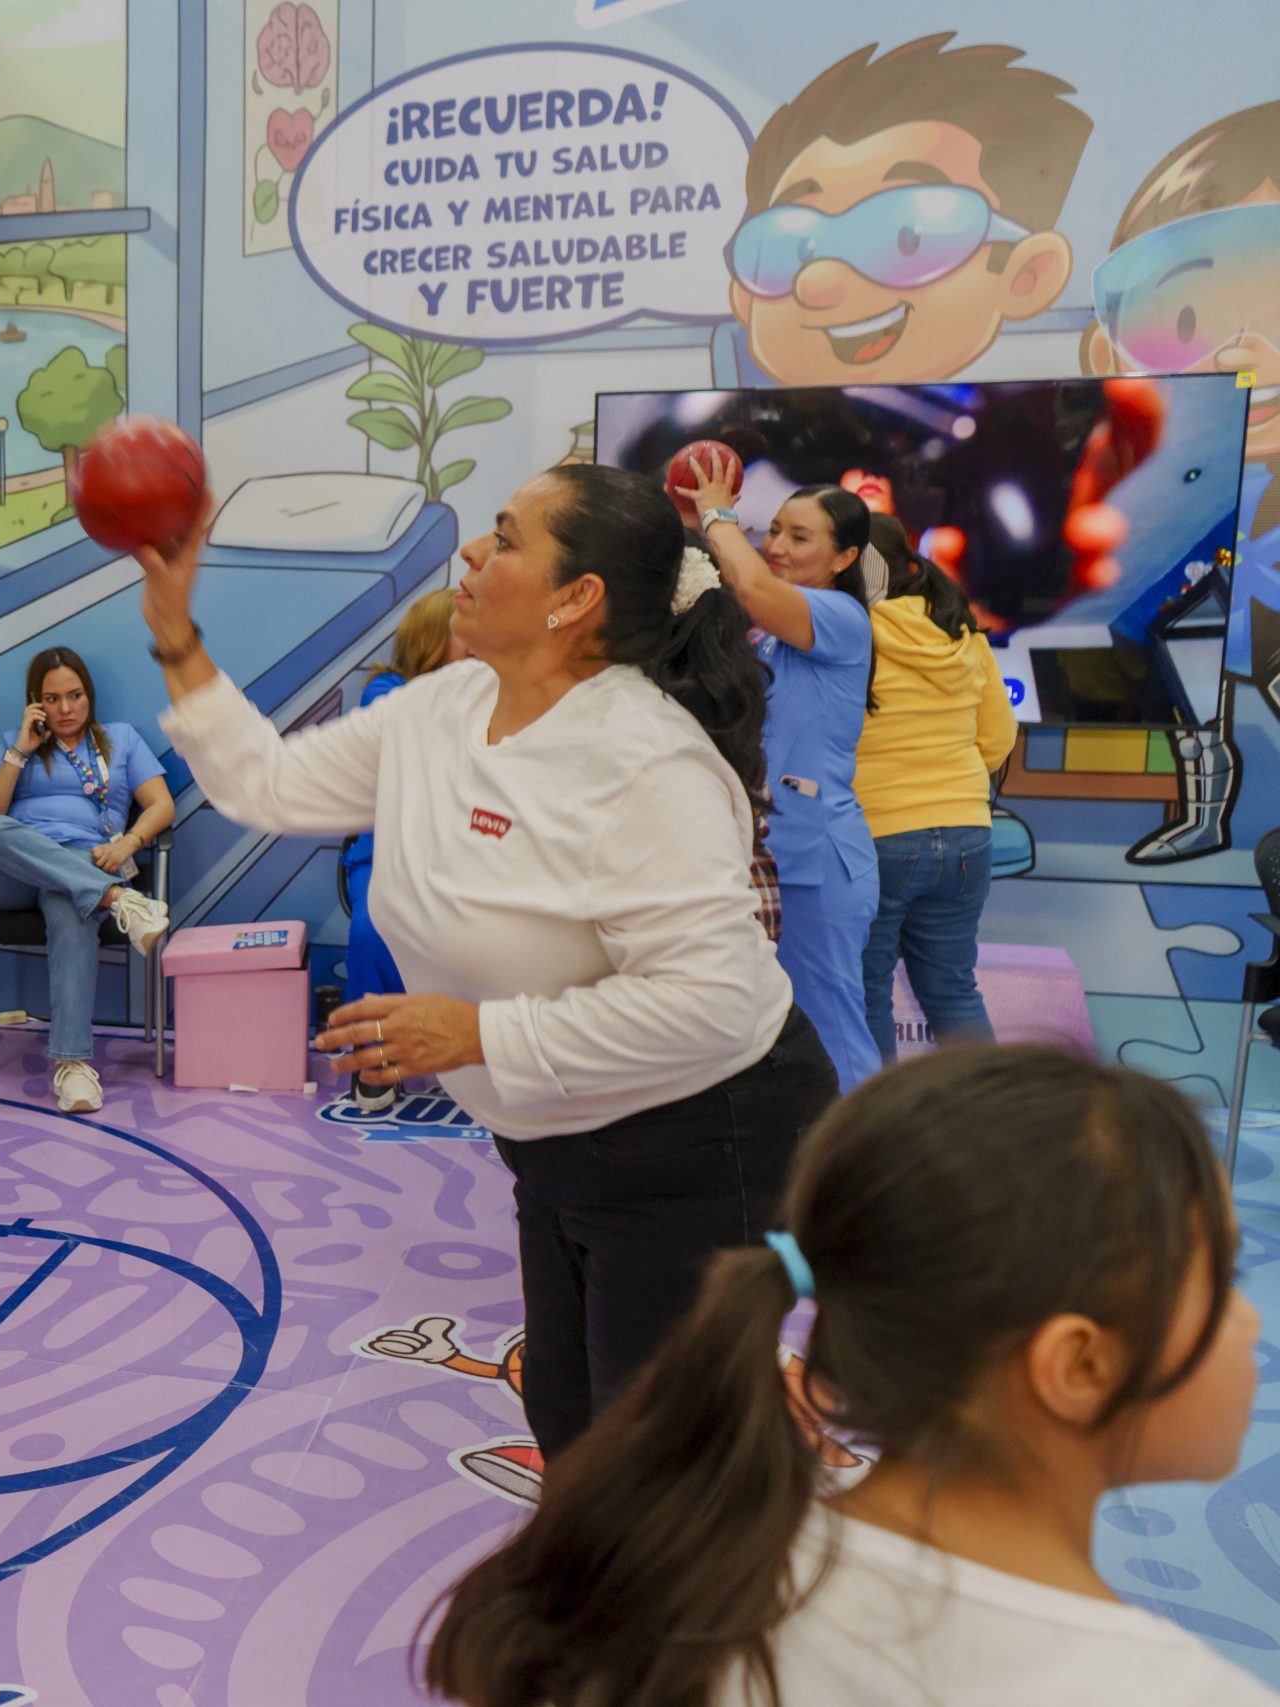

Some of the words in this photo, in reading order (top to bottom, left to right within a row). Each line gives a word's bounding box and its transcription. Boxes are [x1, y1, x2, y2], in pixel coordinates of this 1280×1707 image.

[386, 81, 669, 145] ¡RECUERDA!
[384, 153, 480, 187] CUIDA
[495, 150, 537, 179] TU
[552, 141, 669, 175] SALUD
[334, 198, 433, 235] FÍSICA
[447, 200, 470, 227] Y
[483, 190, 615, 224] MENTAL
[629, 182, 721, 216] PARA
[363, 244, 472, 276] CRECER
[487, 230, 687, 269] SALUDABLE
[418, 281, 448, 316] Y
[467, 271, 625, 315] FUERTE
